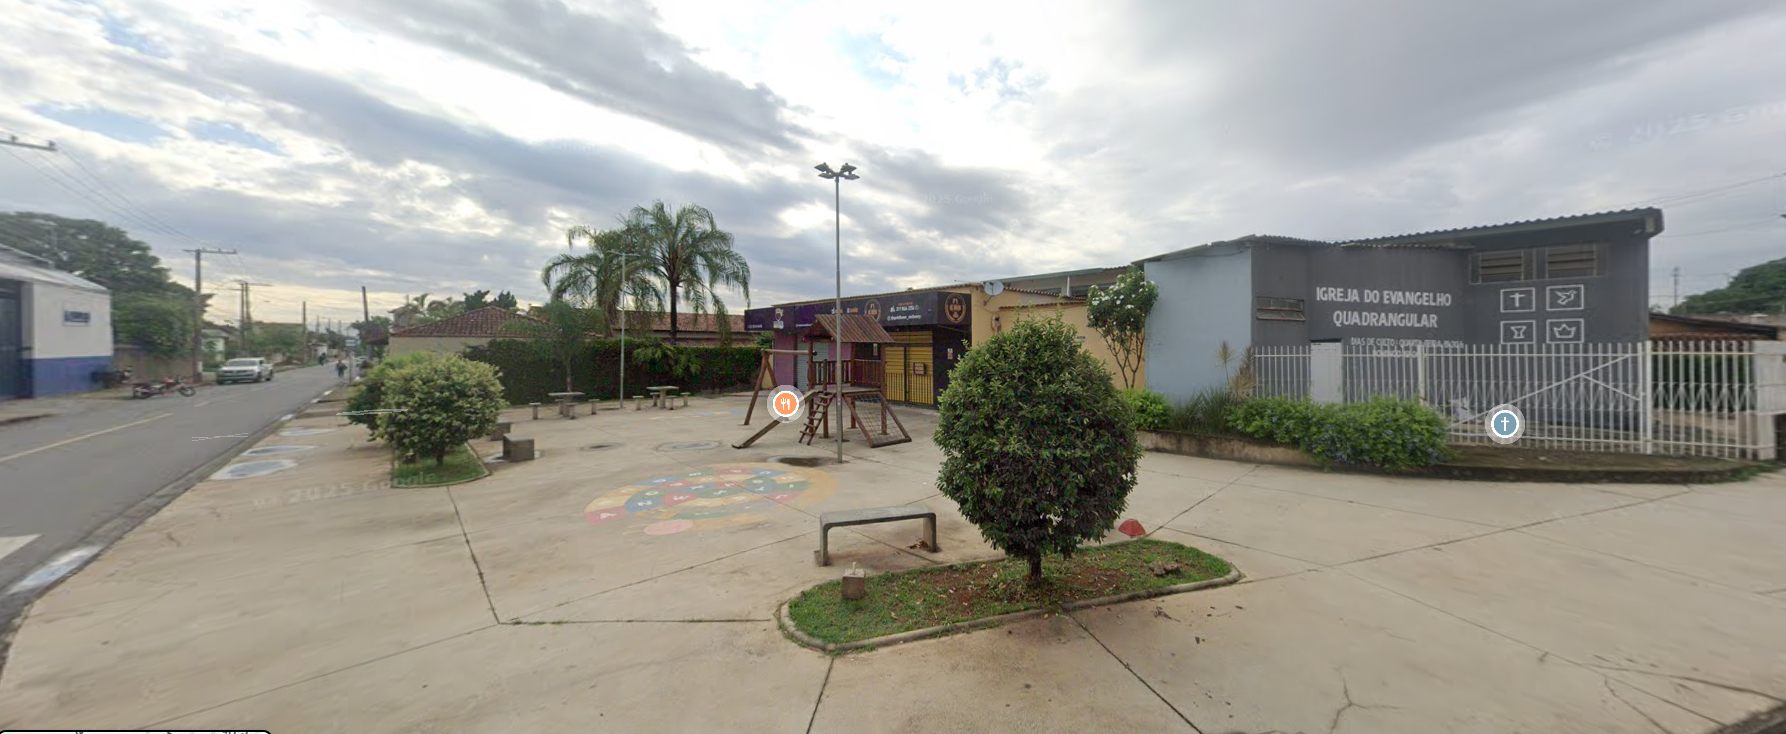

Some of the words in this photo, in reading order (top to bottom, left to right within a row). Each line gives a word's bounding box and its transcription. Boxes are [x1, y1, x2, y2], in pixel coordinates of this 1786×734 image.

[1316, 286, 1359, 303] IGREJA
[1364, 289, 1380, 304] DO
[1383, 290, 1452, 307] EVANGELHO
[1333, 310, 1438, 328] QUADRANGULAR
[1351, 337, 1365, 346] DIAS
[1366, 337, 1375, 346] DE
